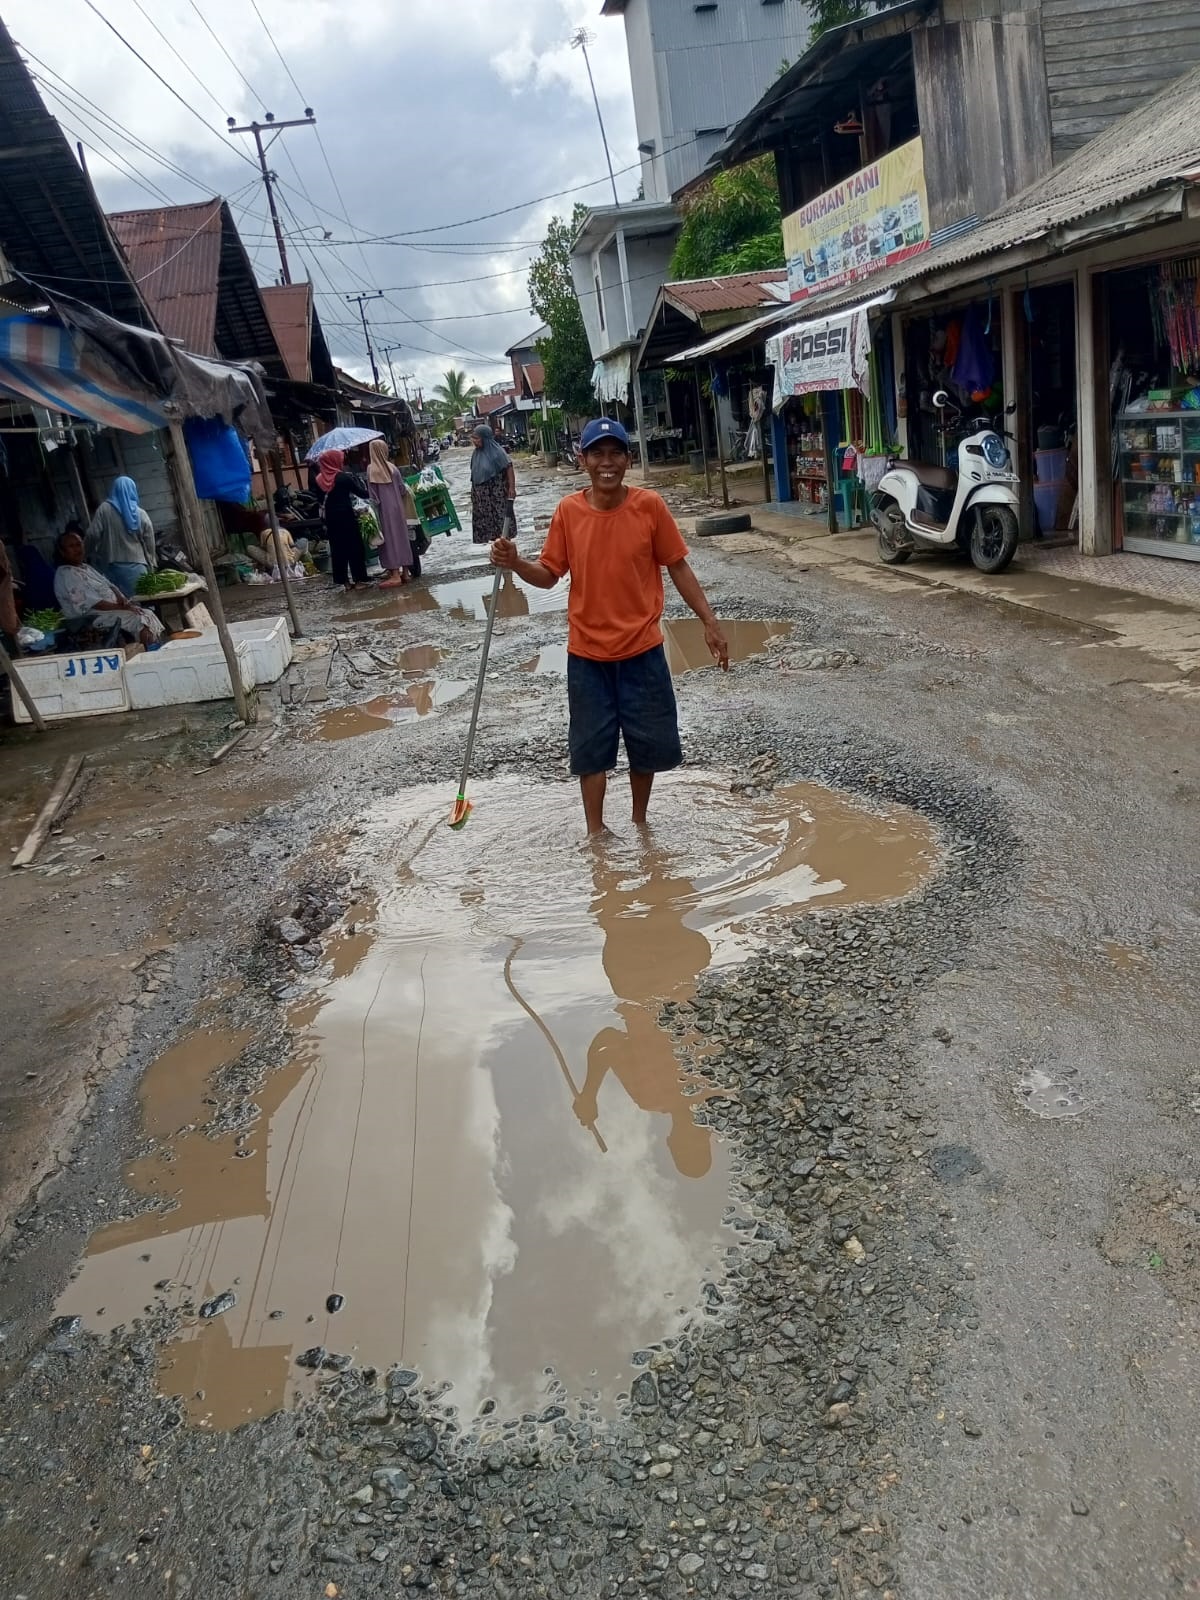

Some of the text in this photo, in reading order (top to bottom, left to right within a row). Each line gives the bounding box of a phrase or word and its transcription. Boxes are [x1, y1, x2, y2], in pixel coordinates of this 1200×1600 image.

[800, 186, 845, 228] BURHAN
[847, 166, 879, 200] TANI
[790, 326, 848, 363] ROSSI
[65, 655, 119, 677] AFIF
